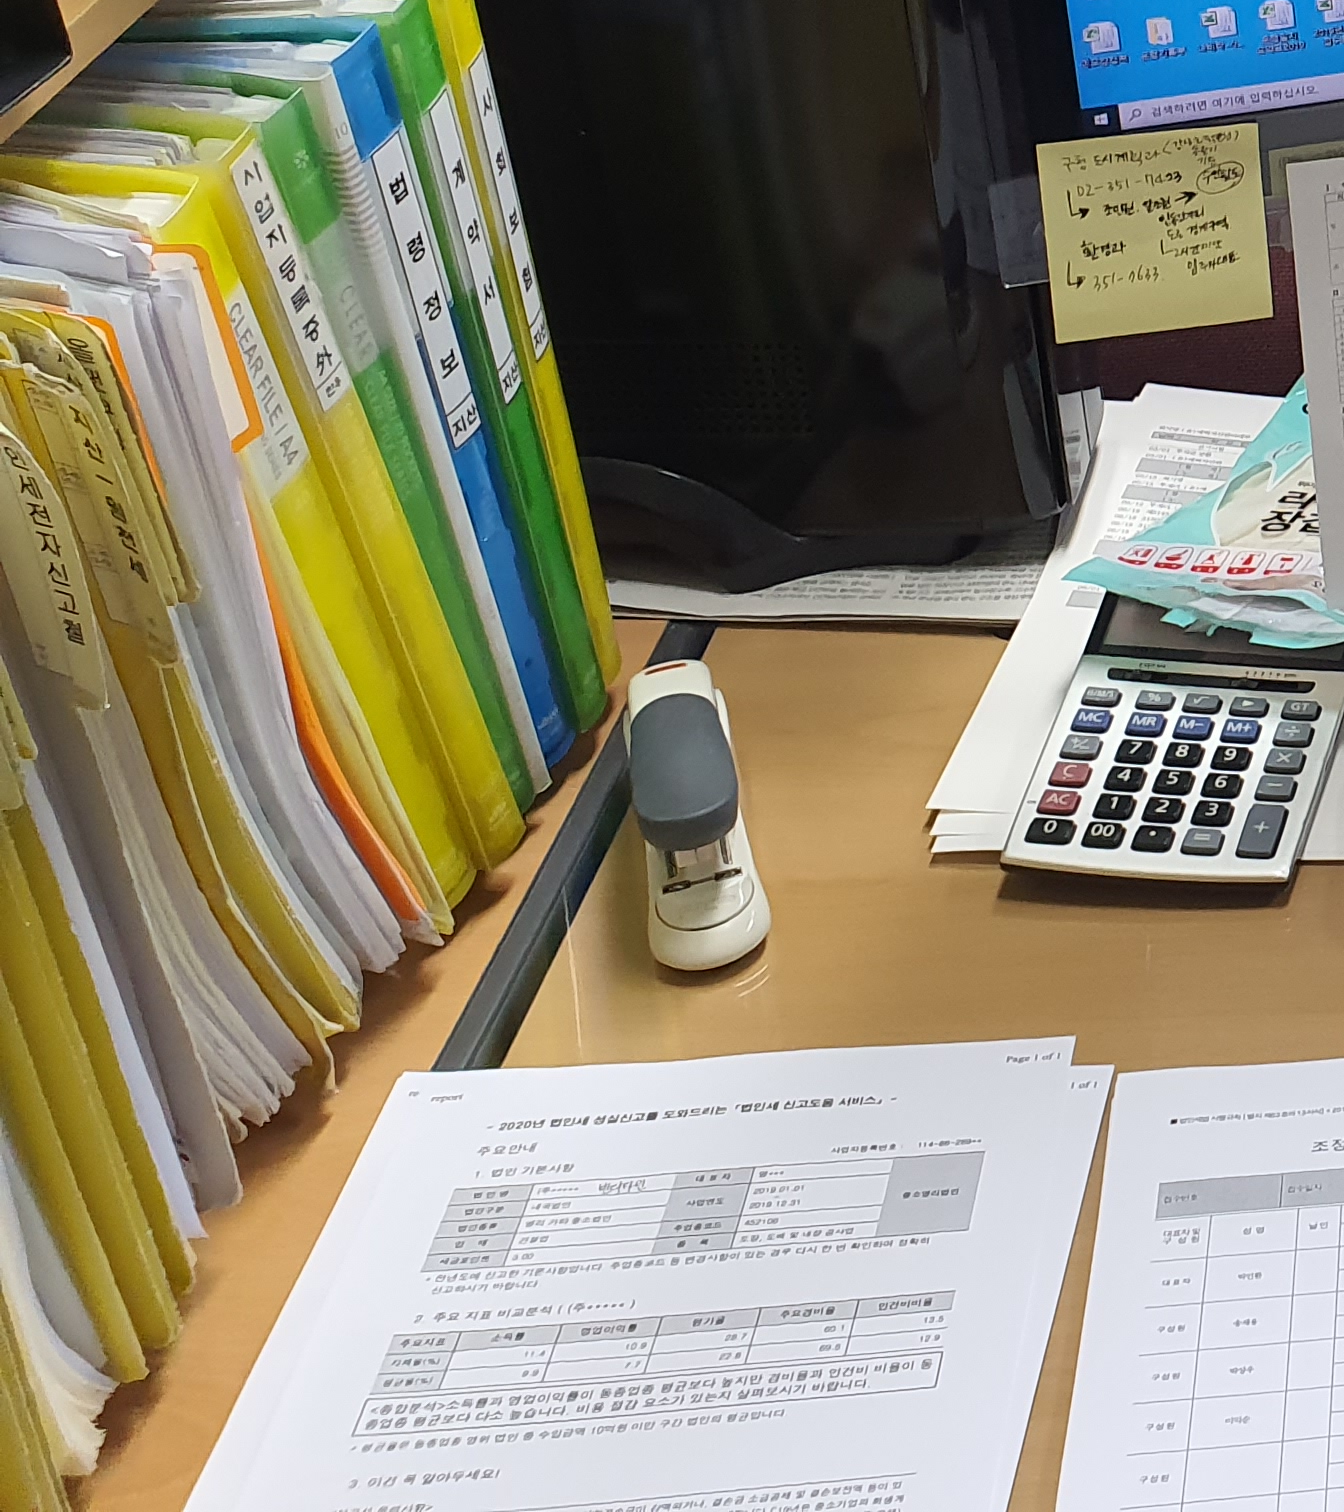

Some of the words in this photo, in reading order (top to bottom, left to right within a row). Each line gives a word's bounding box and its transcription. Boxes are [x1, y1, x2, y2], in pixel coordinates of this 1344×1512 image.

[1151, 99, 1207, 119] 검색하려면
[1211, 94, 1246, 110] 여기에
[451, 159, 497, 306] 계약서
[389, 172, 460, 381] 법령정보
[1290, 701, 1310, 712] GT
[1077, 711, 1104, 724] MC
[1131, 714, 1158, 728] MR
[1226, 721, 1253, 734] M+
[1128, 742, 1144, 755] 7
[1175, 744, 1189, 758] 8
[1223, 748, 1238, 763] 9
[1045, 793, 1071, 806] AC
[1090, 823, 1116, 838] 00
[1006, 1054, 1031, 1066] Page
[498, 1117, 546, 1132] 2020년
[550, 1114, 590, 1128] 법인세
[662, 1104, 728, 1120] 도와드리는
[477, 1141, 538, 1156] 주요안내
